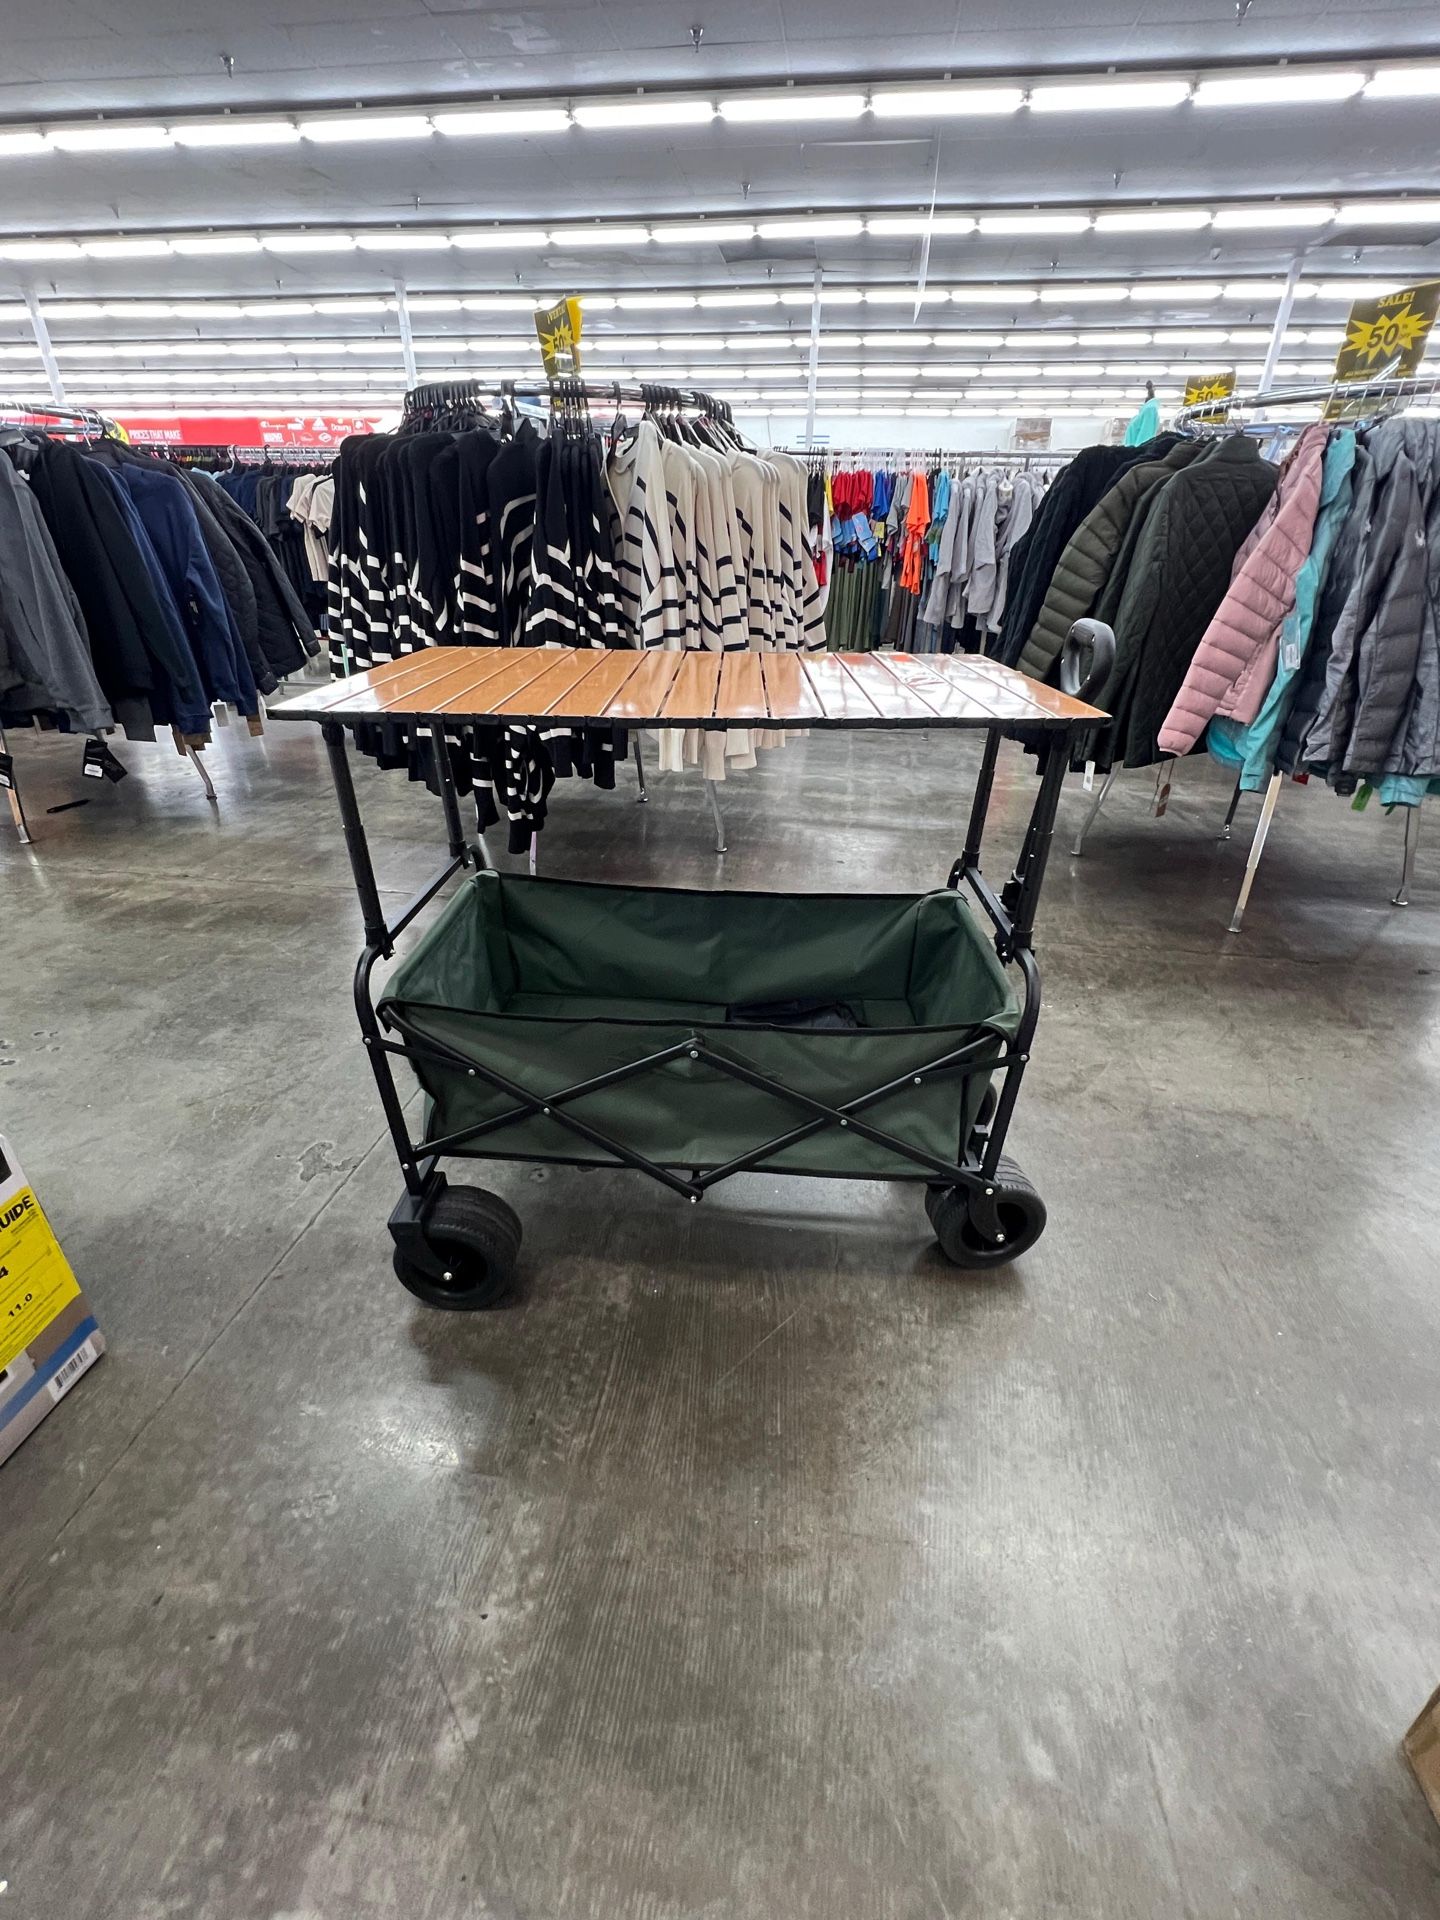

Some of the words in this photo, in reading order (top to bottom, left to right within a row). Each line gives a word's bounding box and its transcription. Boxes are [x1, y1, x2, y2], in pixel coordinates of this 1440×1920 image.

[1377, 291, 1416, 308] SALE!
[128, 429, 150, 439] PRICES
[150, 429, 164, 439] THAT
[164, 429, 181, 439] MAKE
[0, 1195, 34, 1232] UIDE
